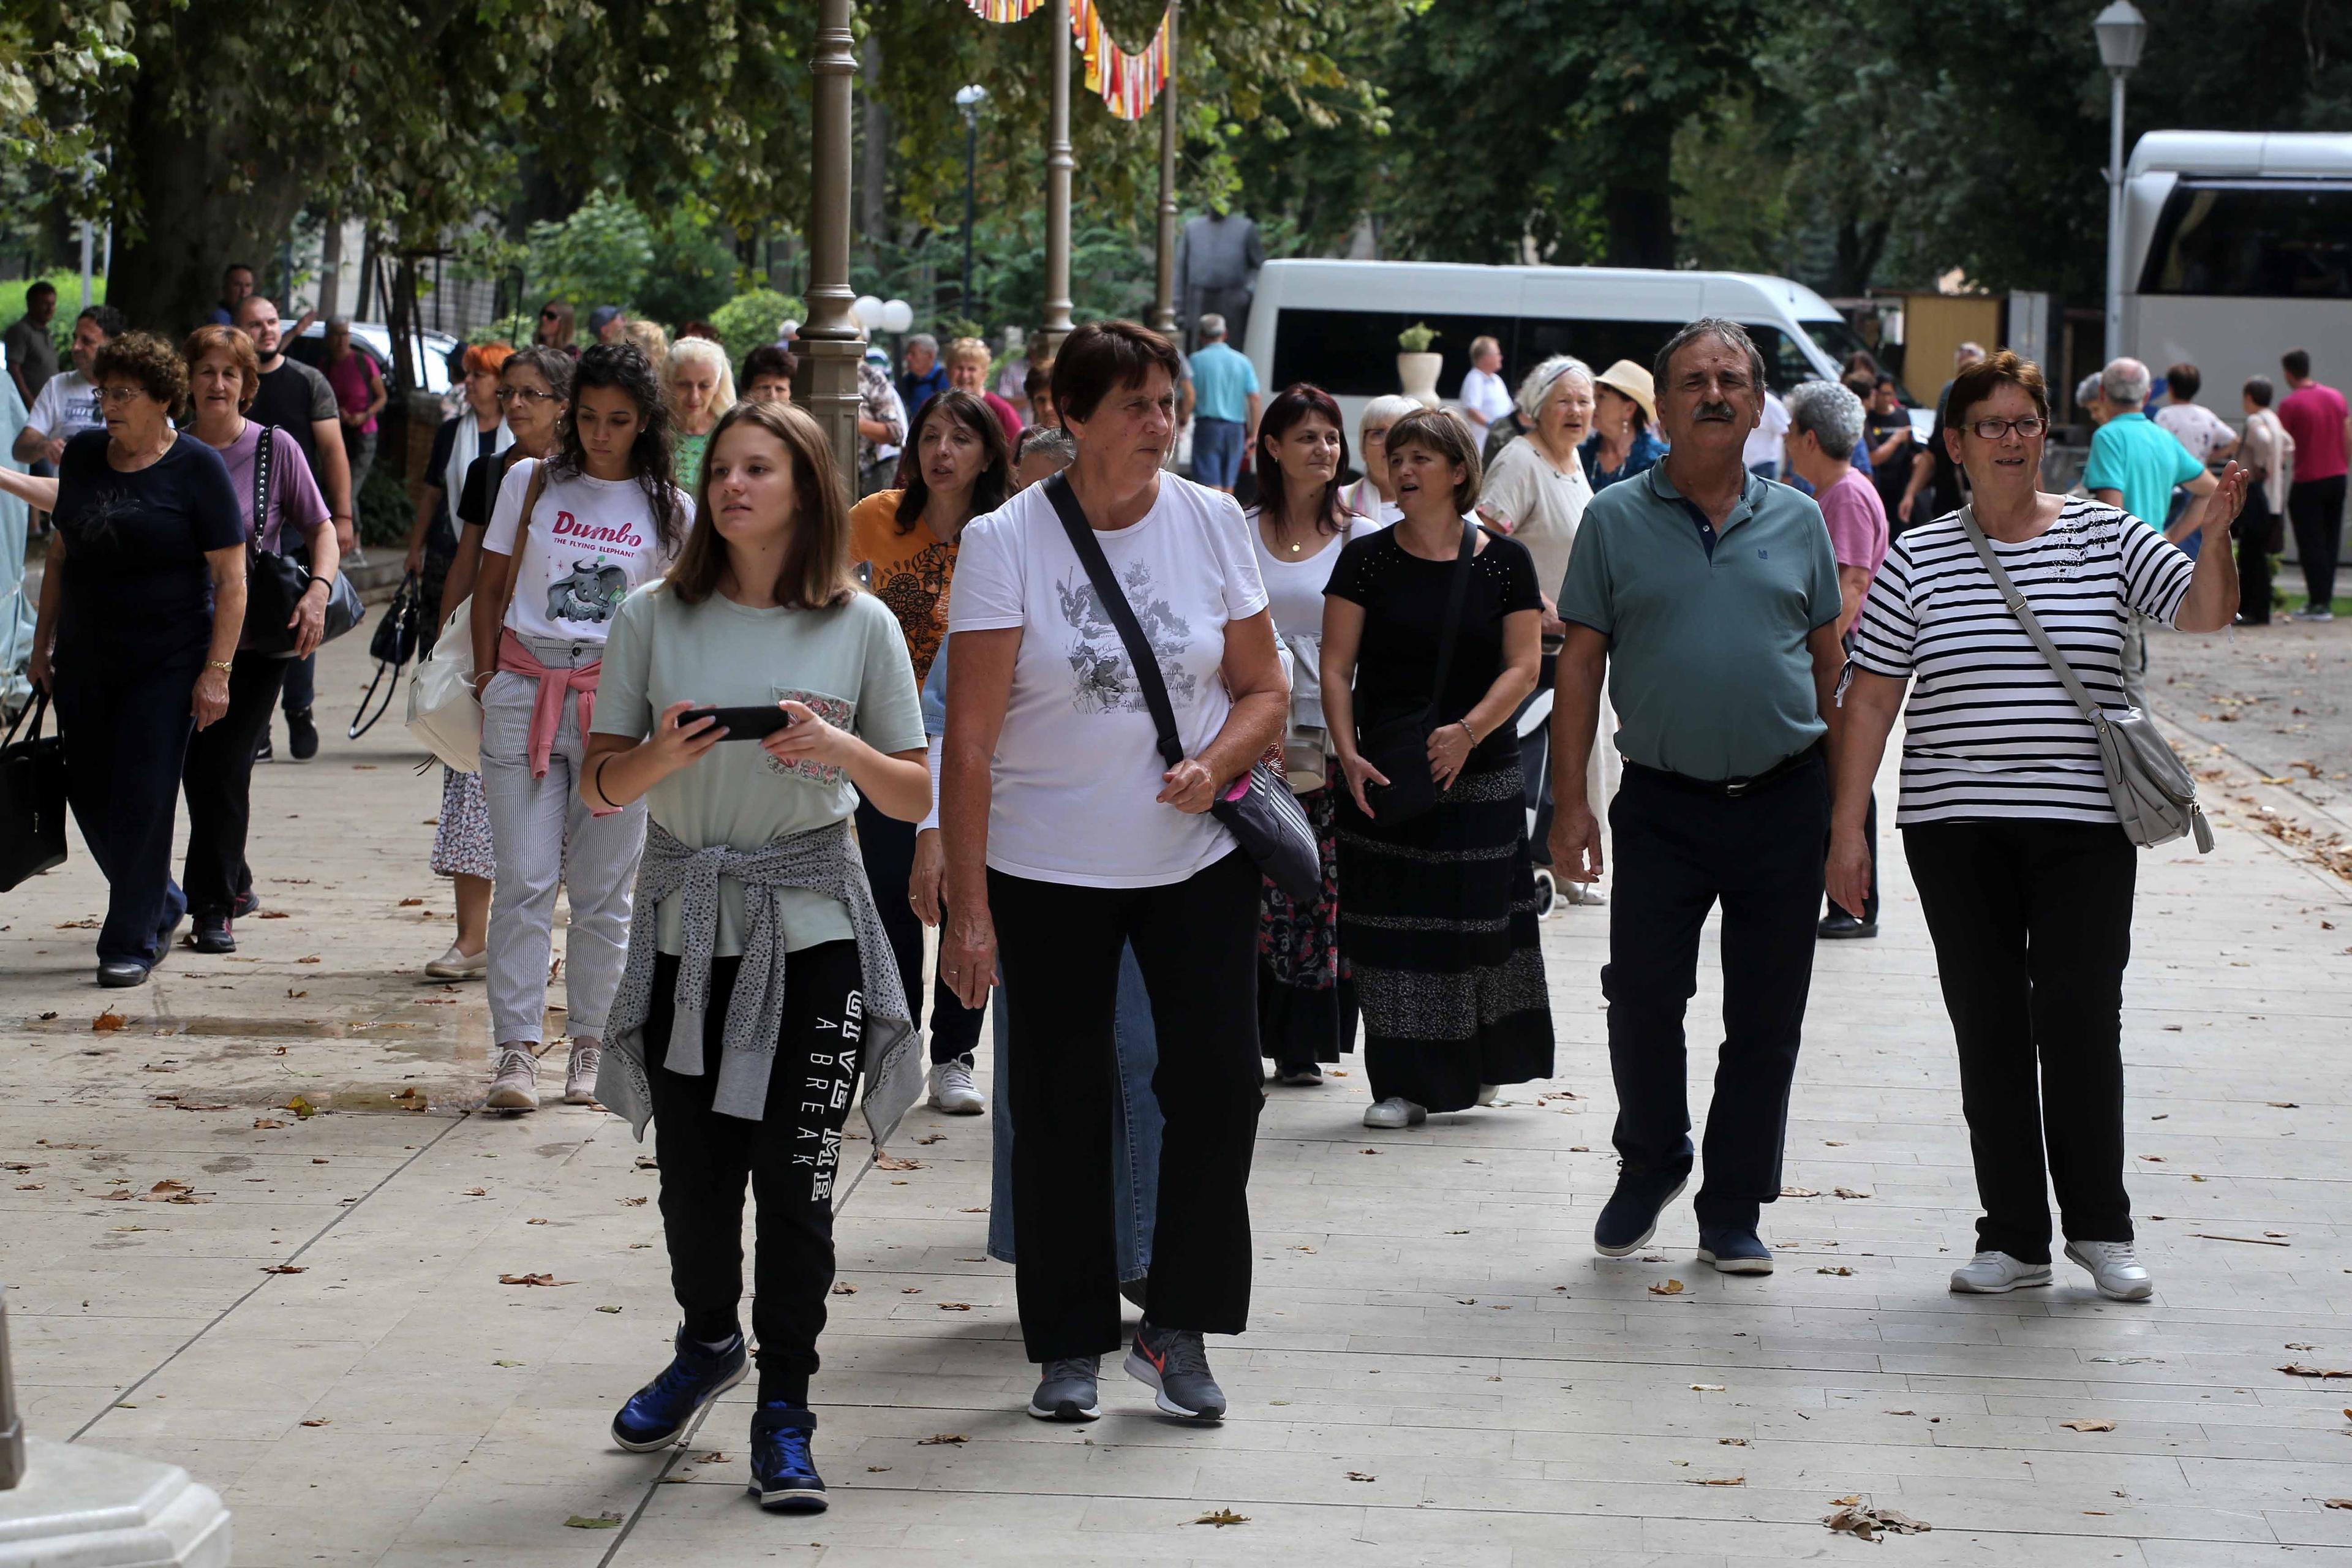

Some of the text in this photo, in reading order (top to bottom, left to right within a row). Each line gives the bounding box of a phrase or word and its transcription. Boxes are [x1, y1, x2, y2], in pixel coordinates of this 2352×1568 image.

[552, 511, 642, 547] Dumbo
[570, 540, 596, 550] FLYING
[599, 546, 635, 558] ELEPHANT
[792, 1017, 838, 1166] A BREAK
[811, 990, 862, 1201] GIVE ME
